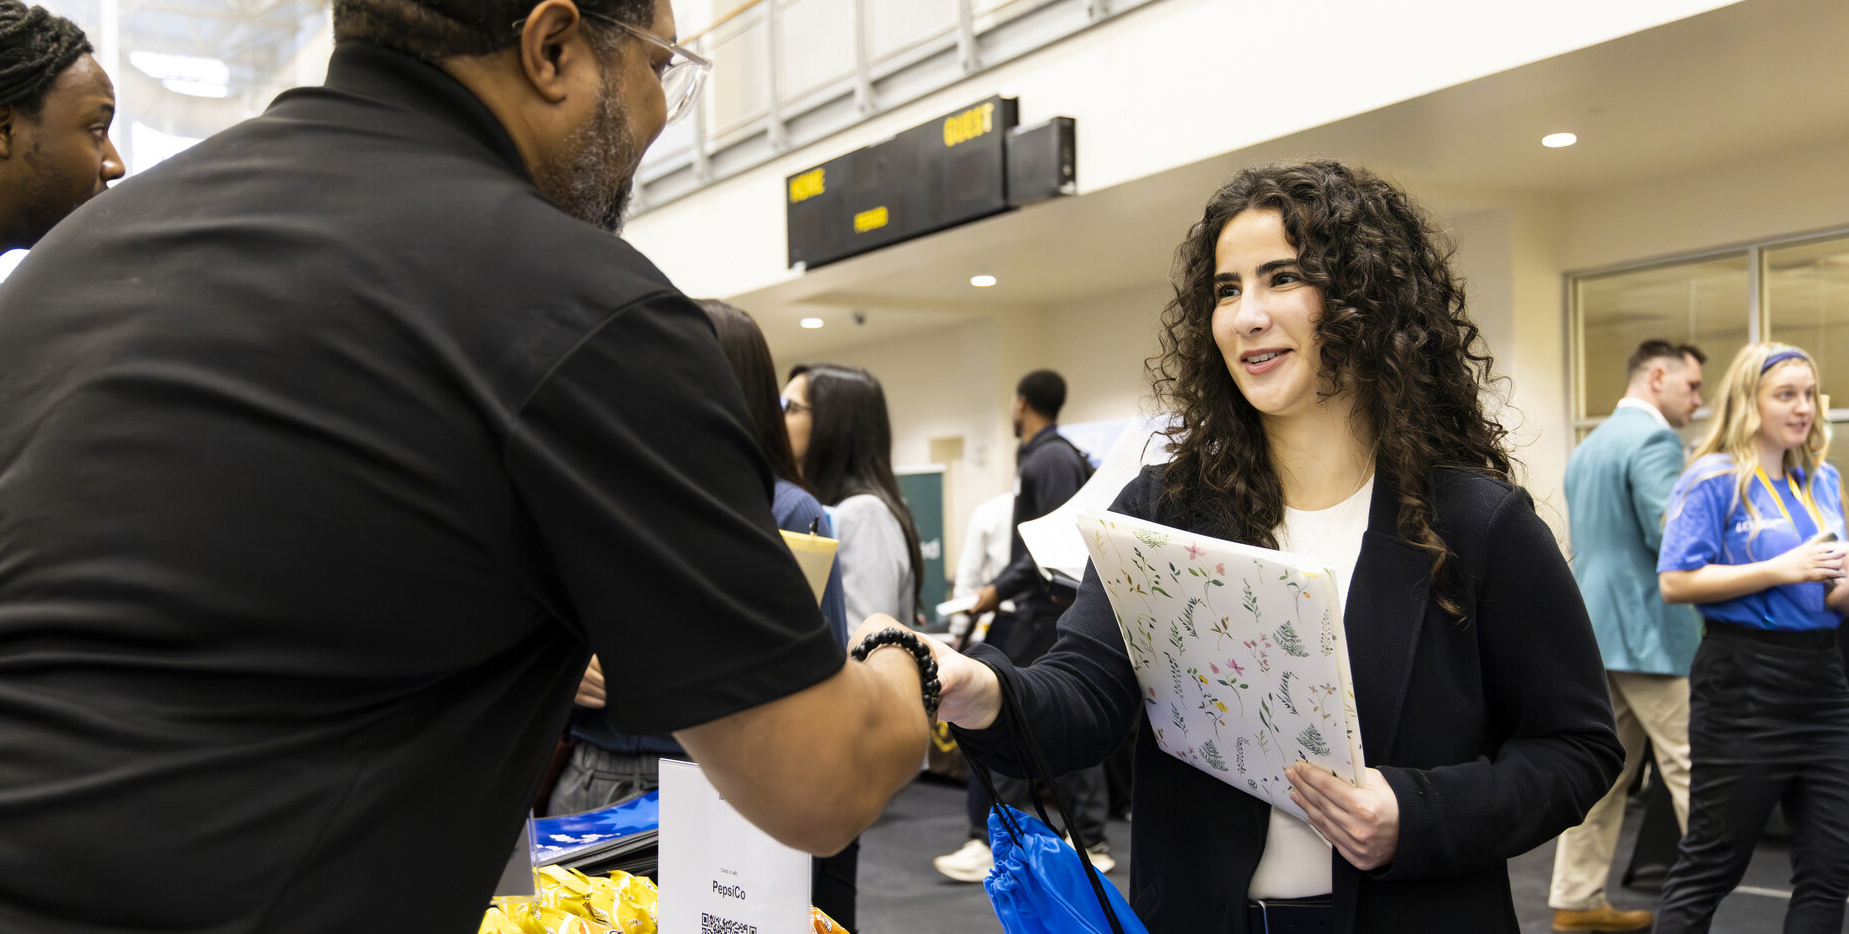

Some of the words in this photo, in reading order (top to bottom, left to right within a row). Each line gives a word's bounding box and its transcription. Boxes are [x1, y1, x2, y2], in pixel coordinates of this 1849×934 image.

[943, 101, 994, 147] GUEST
[789, 167, 826, 204] HOME
[712, 880, 746, 900] PepsiCo
